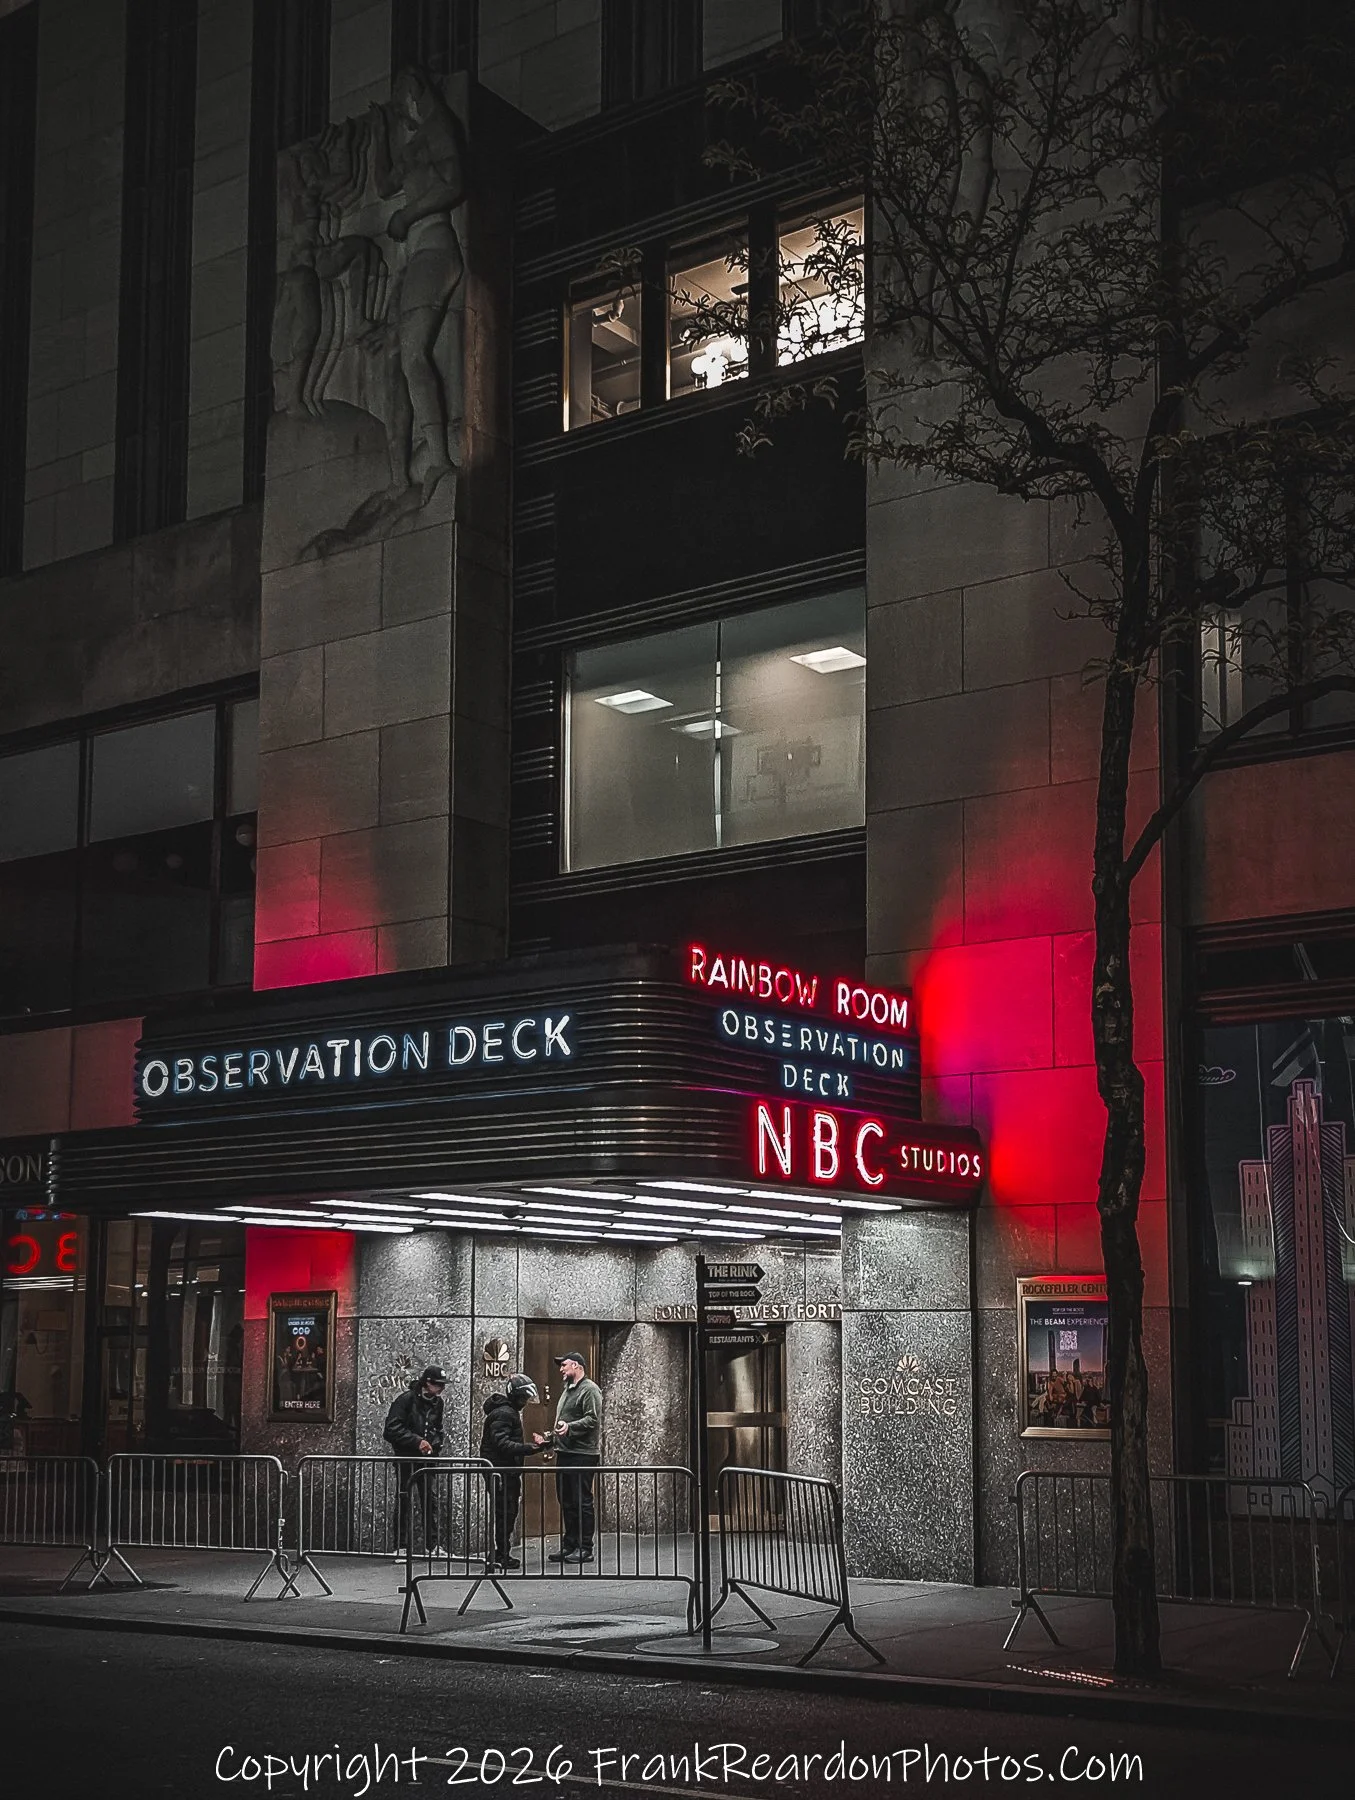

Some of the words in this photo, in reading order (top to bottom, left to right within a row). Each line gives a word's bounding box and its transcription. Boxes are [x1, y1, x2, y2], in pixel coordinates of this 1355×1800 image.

[691, 947, 818, 1007] RAINBOW
[837, 982, 908, 1028] ROOM
[722, 1010, 904, 1068] OBSERVATION
[142, 1031, 430, 1097] OBSERVATION
[448, 1015, 571, 1066] DECK
[783, 1064, 849, 1097] DECK
[757, 1105, 885, 1186] NBC
[901, 1145, 982, 1178] STUDIOS
[707, 1265, 728, 1278] THE
[730, 1265, 758, 1278] RINK
[1022, 1283, 1078, 1295] ROCKEFELLER
[1081, 1283, 1108, 1294] CENT
[749, 1304, 790, 1319] WEST
[1029, 1317, 1042, 1327] THE
[1044, 1317, 1065, 1327] BEAM
[1066, 1317, 1109, 1327] EXPERIENCE
[708, 1335, 755, 1344] RESTAURANTS
[484, 1362, 509, 1377] NBC
[860, 1377, 956, 1395] COMCAST
[284, 1400, 304, 1409] ENTER
[305, 1400, 320, 1409] HERE
